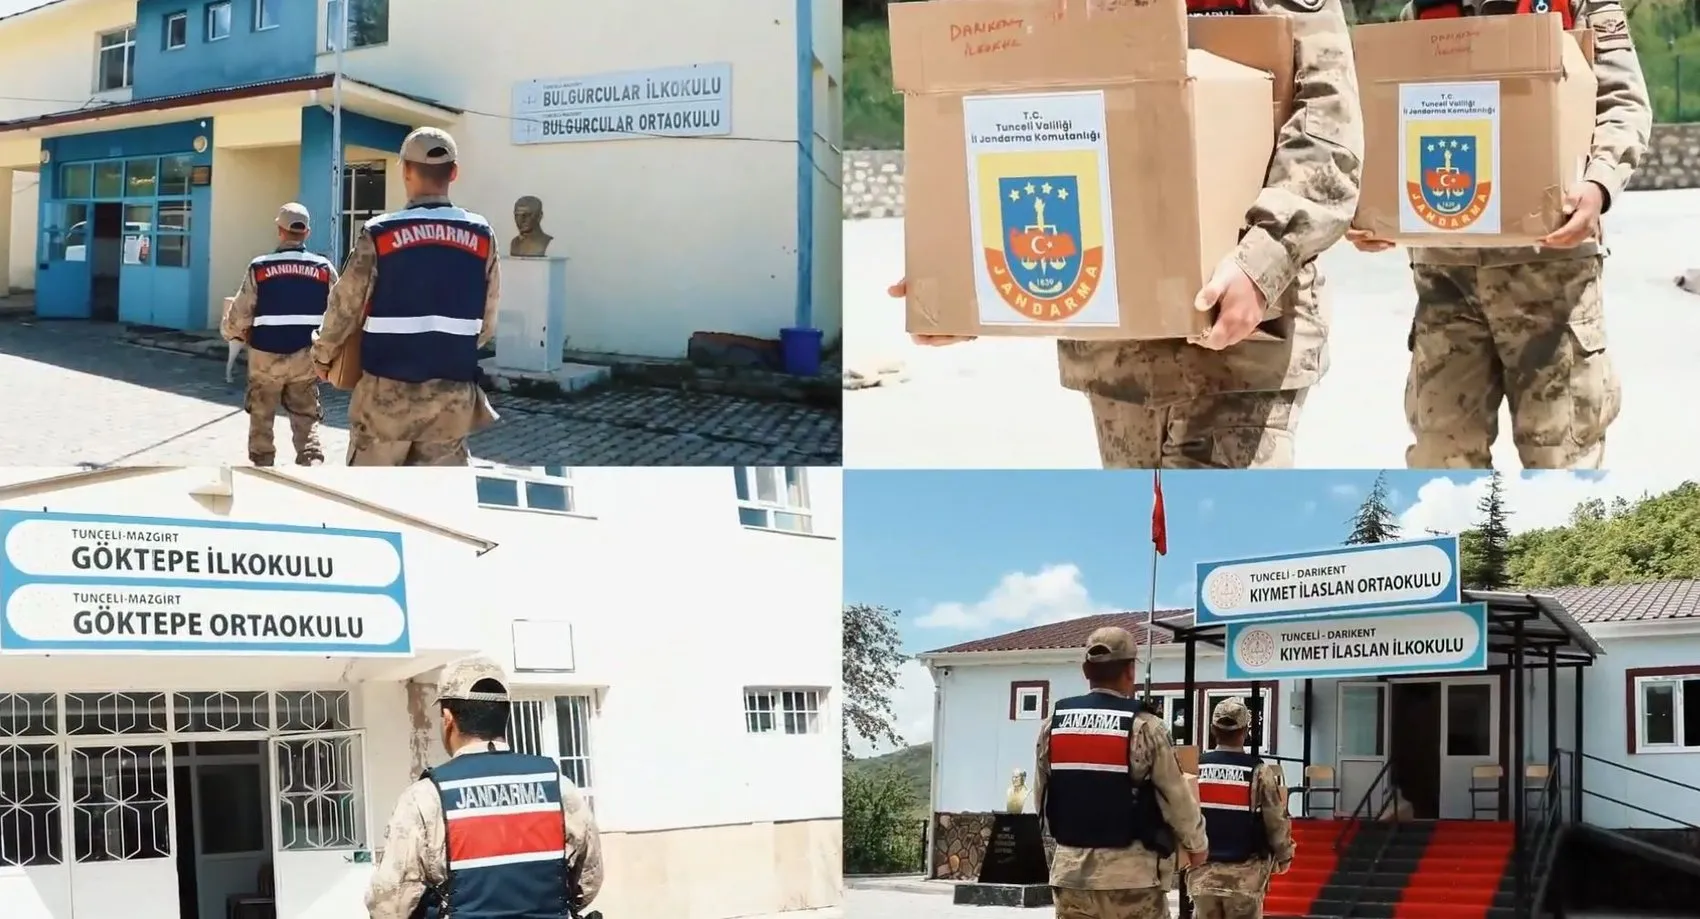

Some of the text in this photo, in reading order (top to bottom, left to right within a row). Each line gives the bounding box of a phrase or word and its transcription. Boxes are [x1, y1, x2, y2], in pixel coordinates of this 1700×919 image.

[543, 77, 721, 107] BULGURCULAR İLKOKULU
[542, 109, 721, 136] BULGURCULAR ORTAOKULU
[996, 120, 1072, 132] Tunceli Valiliği
[1023, 111, 1043, 120] T.C.
[980, 133, 1032, 143] Jandarma
[1034, 130, 1100, 142] Komutanlığı
[1412, 193, 1487, 227] JANDARMA
[392, 224, 478, 250] JANDARMA
[265, 264, 320, 280] JANDARMA
[994, 266, 1098, 317] JANDARMA
[72, 541, 333, 578] GÖKTEPE İLKOKULU
[1250, 569, 1290, 583] TUNCELİ
[1297, 565, 1347, 579] DARIKENT
[1250, 572, 1442, 603] KIYMET İLASLAN ORTAOKULU
[73, 605, 363, 639] GÖKTEPE ORTAOKULU
[1281, 629, 1320, 642] TUNCELİ
[1327, 628, 1376, 640] DARIKENT
[1280, 637, 1464, 661] KIYMET İLASLAN İLKOKULU
[1059, 714, 1121, 731] JANDARMA
[456, 782, 548, 809] JANDARMA
